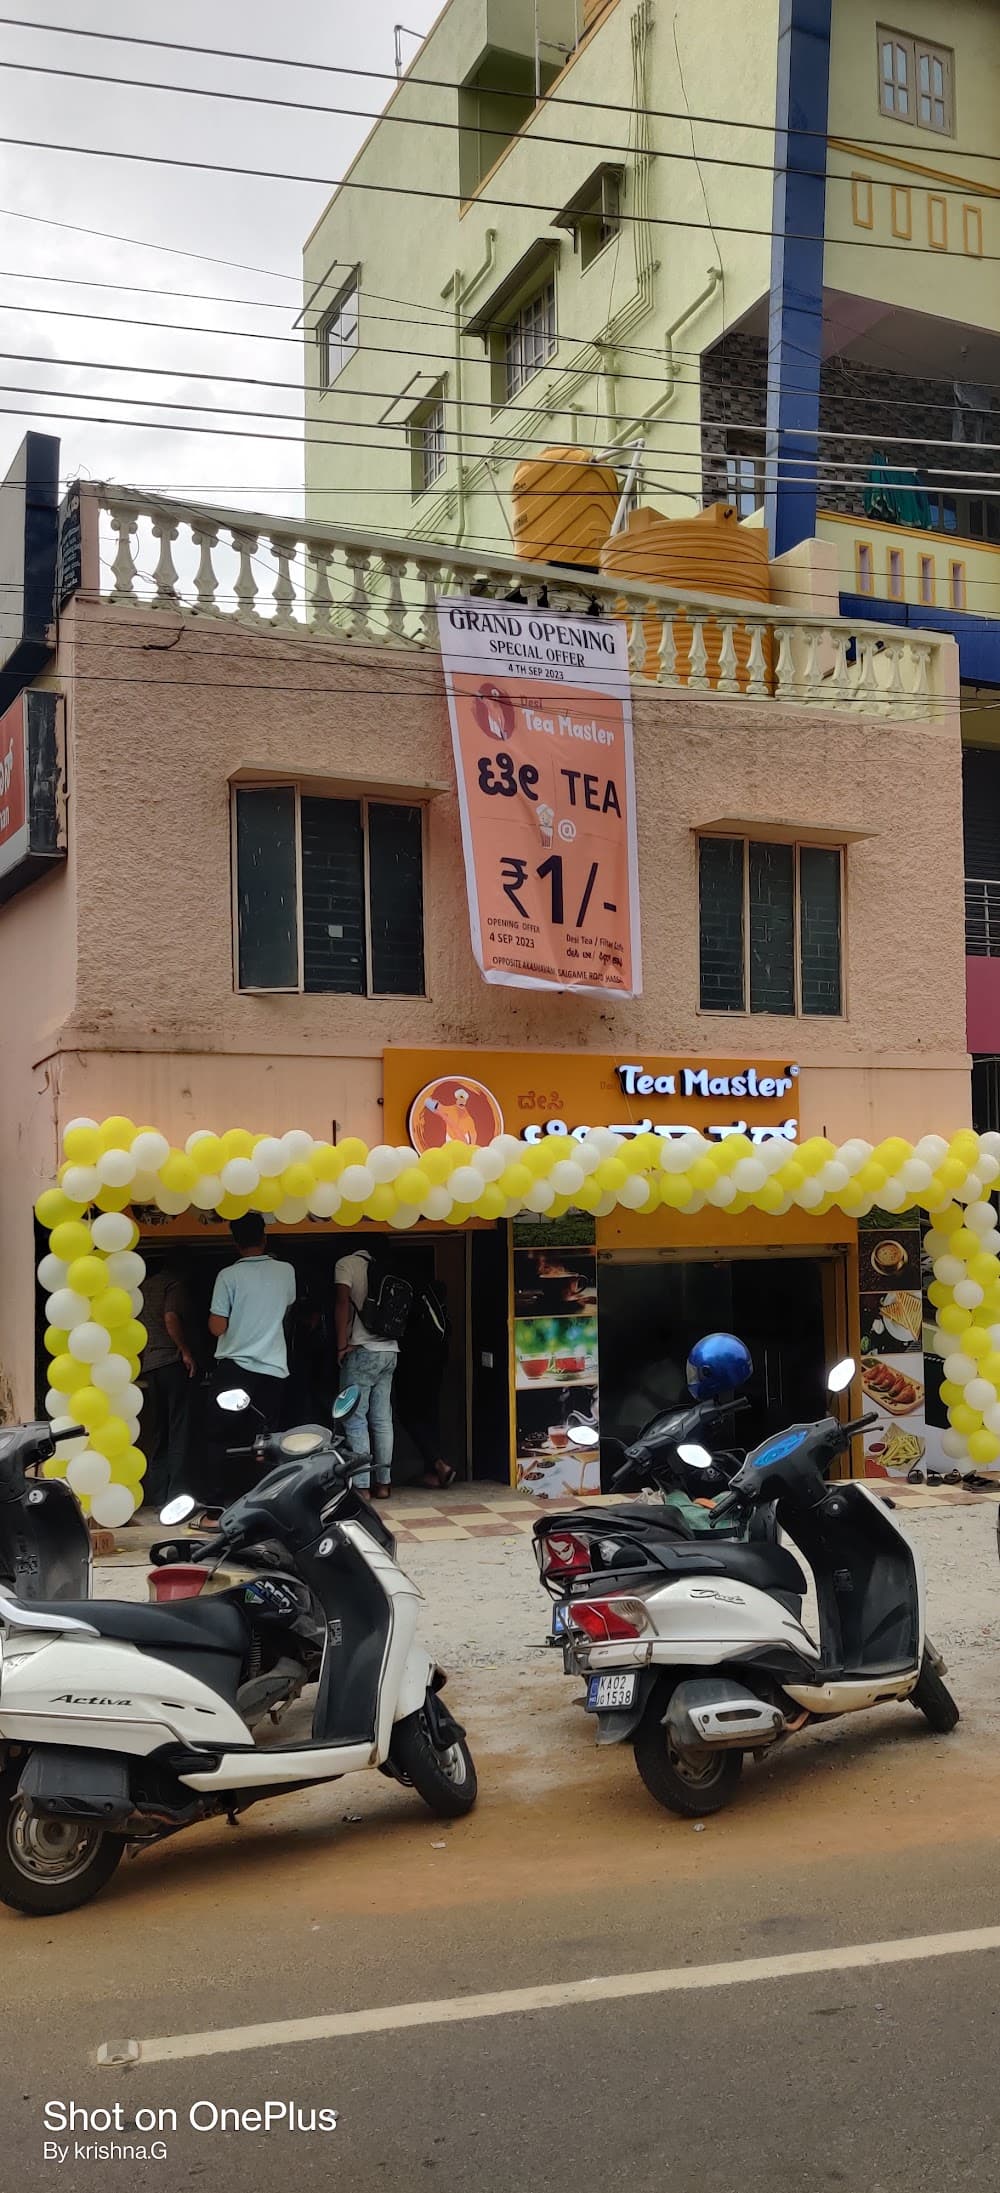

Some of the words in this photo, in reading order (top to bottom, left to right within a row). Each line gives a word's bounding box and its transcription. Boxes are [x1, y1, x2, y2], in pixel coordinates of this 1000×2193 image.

[449, 608, 522, 637] GRAND
[528, 621, 616, 654] OPENING
[489, 639, 543, 660] SPECIAL
[546, 648, 585, 667] OFFER
[508, 663, 514, 673] 4
[515, 664, 527, 675] TH
[528, 667, 543, 676] SEP
[545, 669, 564, 680] 2023
[522, 708, 555, 736] Tea
[558, 715, 615, 746] Master
[478, 752, 539, 801] ಟೀ
[560, 768, 622, 819] TEA
[487, 917, 519, 930] OPENING
[489, 931, 495, 942] 4
[497, 932, 513, 945] SEP
[515, 935, 535, 949] 2023
[581, 935, 593, 945] Tea
[492, 956, 521, 970] OPPOSITE
[618, 1064, 676, 1095] Tea
[681, 1067, 793, 1098] Master
[517, 1090, 564, 1110] ದೇಸಿ
[600, 1676, 627, 1690] KA02
[48, 1694, 133, 1706] Activa
